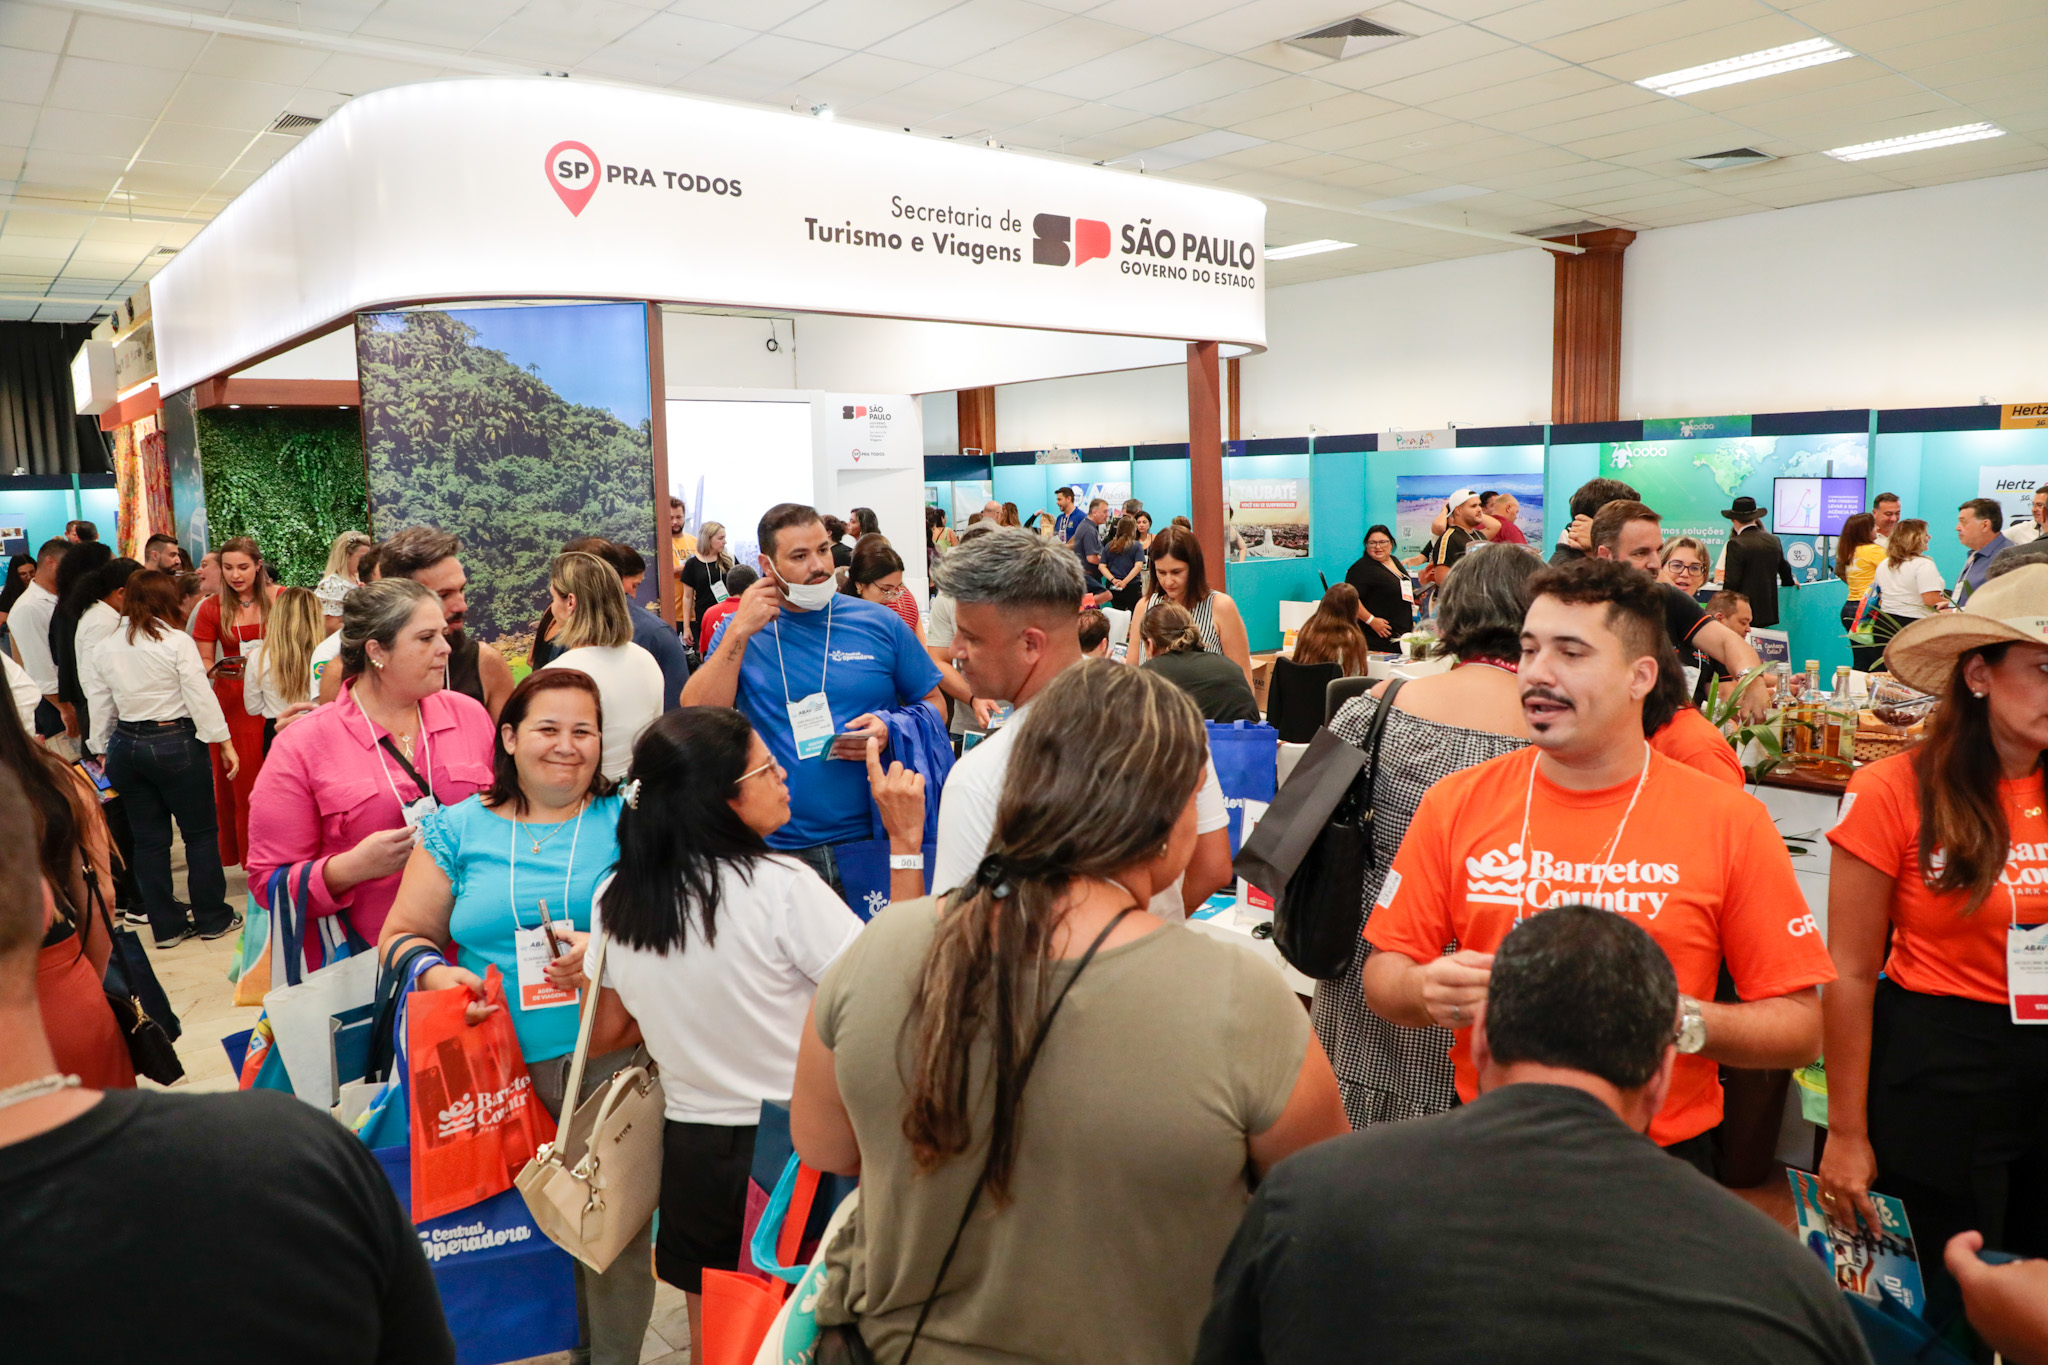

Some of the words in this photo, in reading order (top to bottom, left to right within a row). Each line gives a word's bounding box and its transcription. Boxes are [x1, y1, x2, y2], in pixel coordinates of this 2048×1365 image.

[558, 160, 590, 179] SP
[606, 164, 657, 188] PRA
[663, 170, 743, 198] TODOS
[891, 195, 992, 229] Secretaria
[999, 209, 1022, 232] de
[804, 217, 902, 250] Turismo
[911, 236, 925, 252] e
[932, 232, 1022, 265] Viagens
[1121, 217, 1176, 259] SÃO
[1182, 232, 1255, 270] PAULO
[1120, 260, 1188, 280] GOVERNO
[1192, 269, 1211, 283] DO
[1214, 271, 1255, 289] ESTADO
[869, 404, 884, 413] SÃO
[869, 413, 892, 421] PAULO
[1240, 480, 1297, 500] TAUBATÉ
[1996, 479, 2036, 490] Hertz
[1682, 526, 1725, 537] soluções
[1527, 850, 1680, 884] Barretos
[1525, 878, 1669, 920] Country
[2014, 887, 2041, 895] ARK
[2024, 944, 2047, 952] ABAV
[541, 992, 567, 1000] VIAGENS
[432, 1221, 485, 1242] Central
[422, 1225, 531, 1262] Operadora
